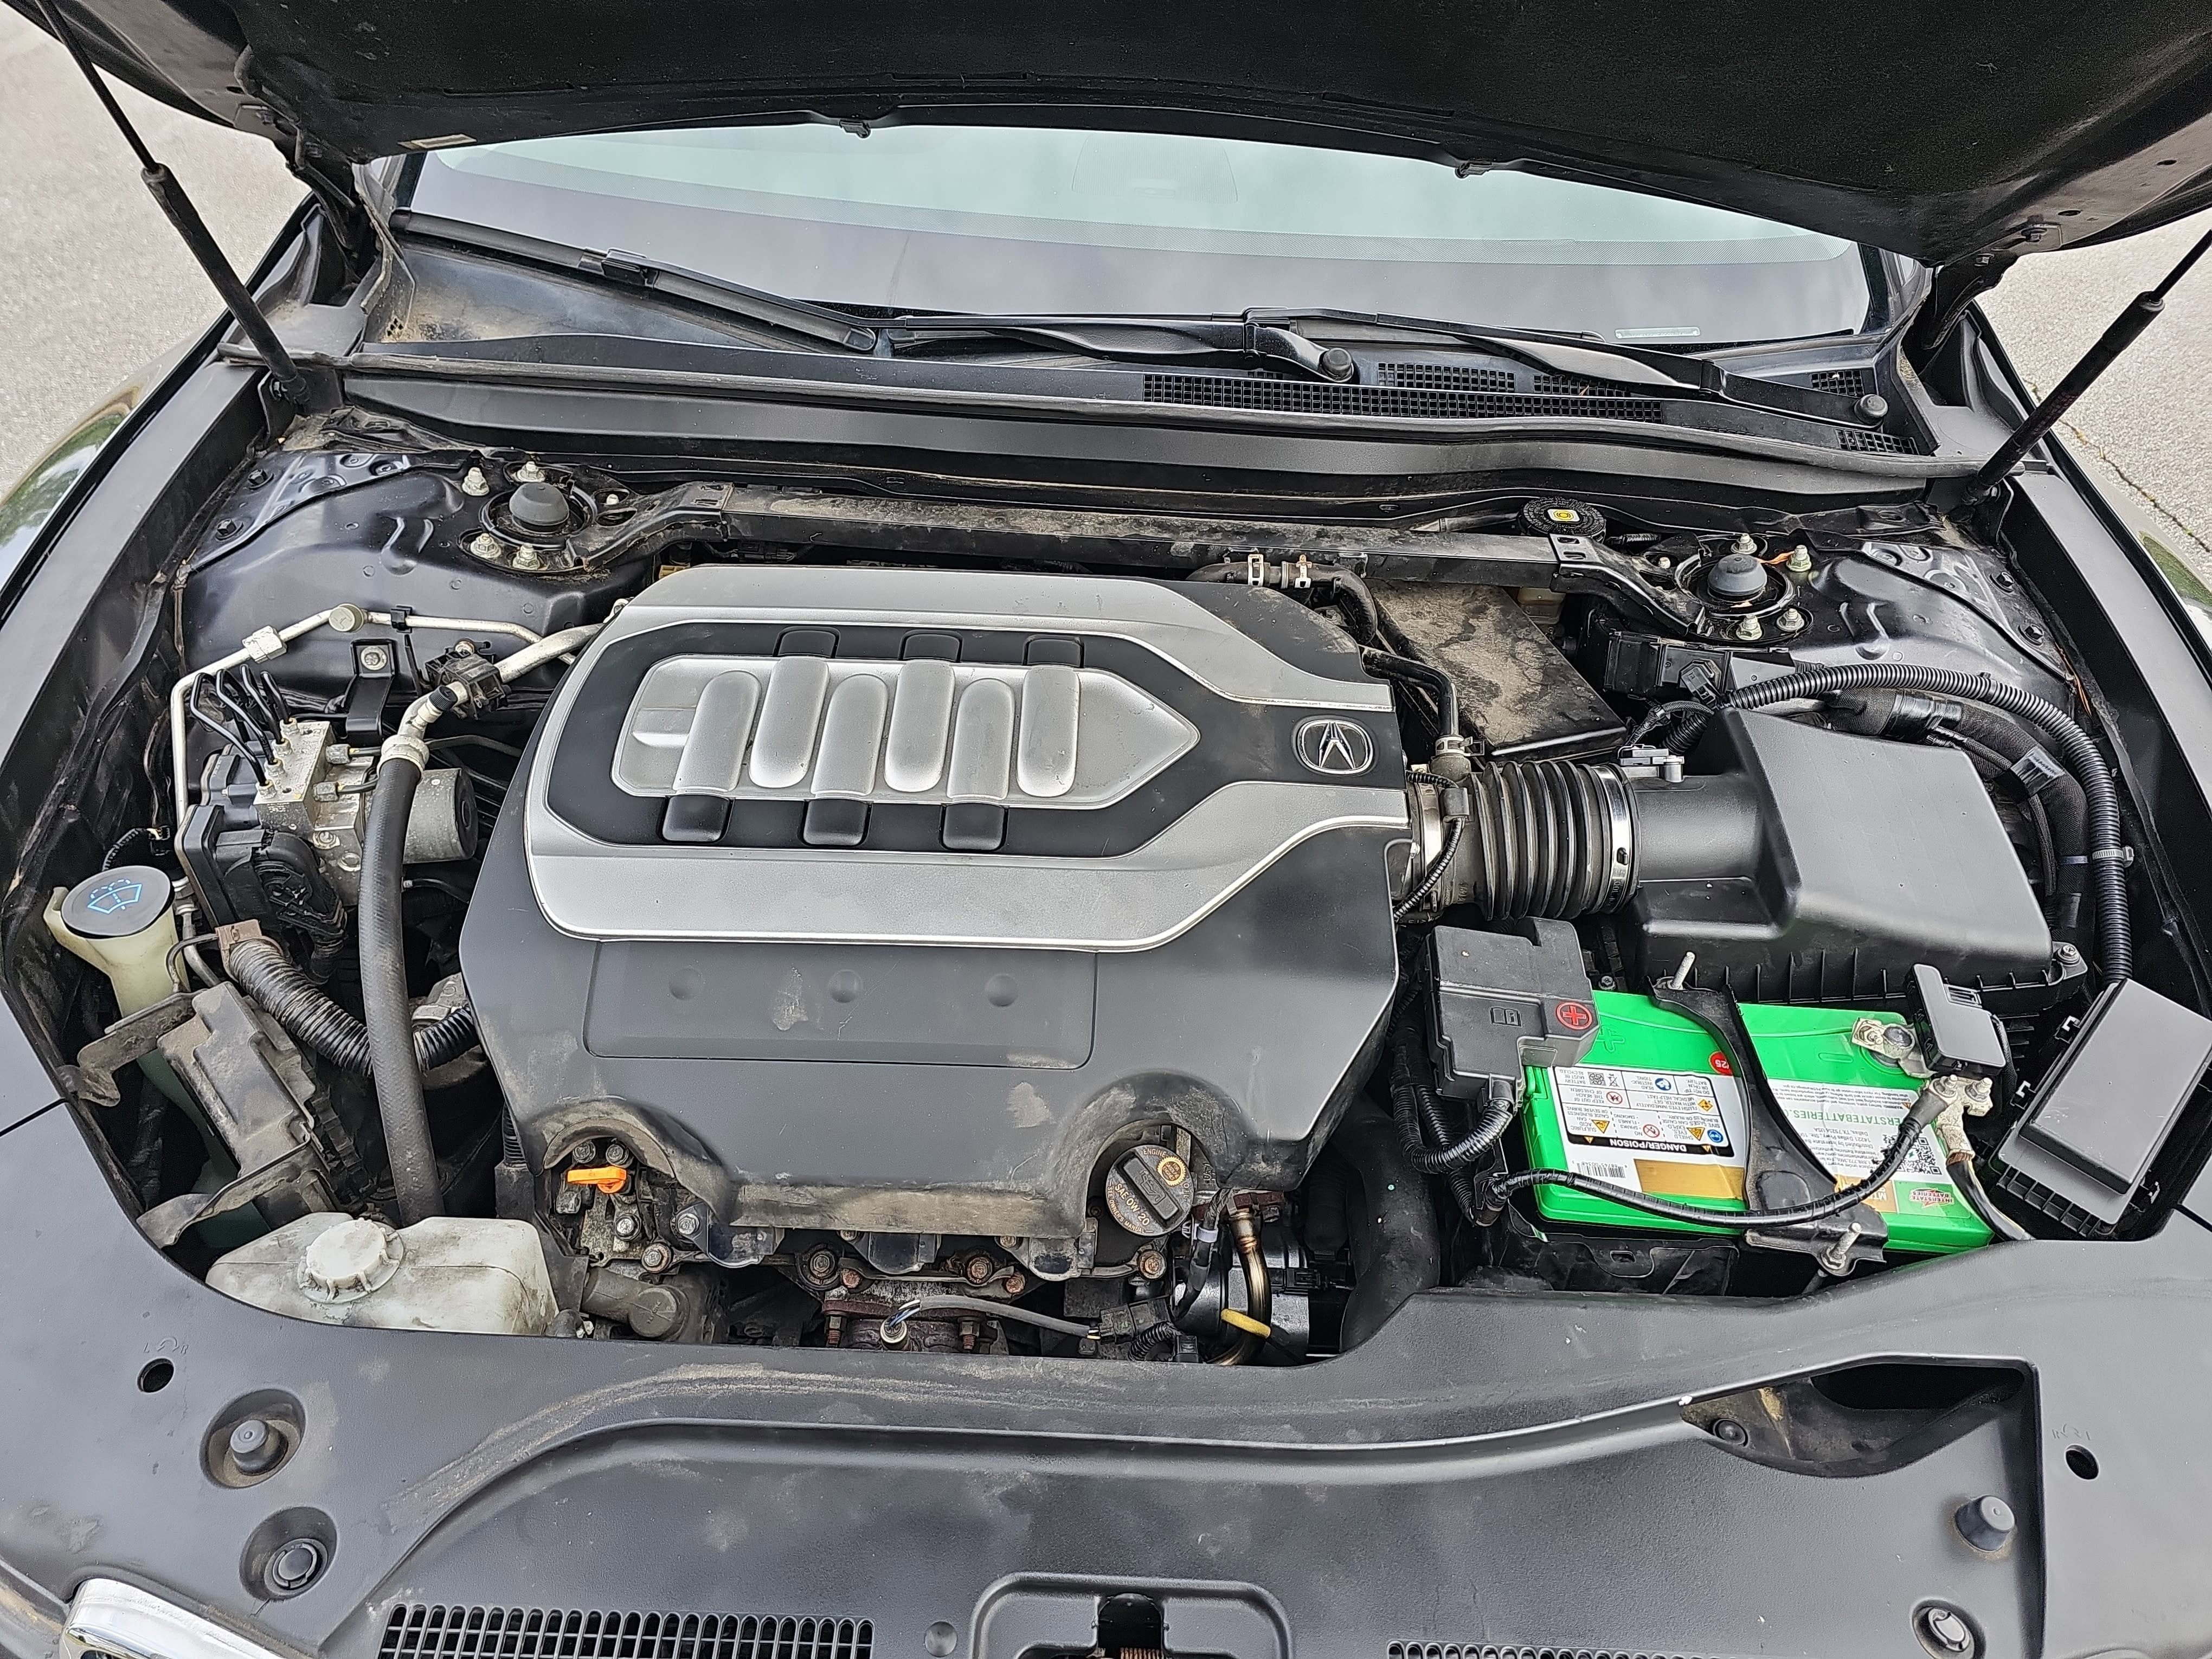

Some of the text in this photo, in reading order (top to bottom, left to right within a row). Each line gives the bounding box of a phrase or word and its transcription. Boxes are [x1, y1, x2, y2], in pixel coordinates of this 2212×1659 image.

[1609, 1138, 1687, 1152] DANGER/POISON
[1143, 1149, 1167, 1158] ENGINE
[1115, 1183, 1129, 1200] SAE
[1137, 1213, 1150, 1225] 20
[1109, 1199, 1124, 1222] OWNER'S
[1124, 1220, 1145, 1233] MANUAL
[144, 1342, 189, 1354] L R
